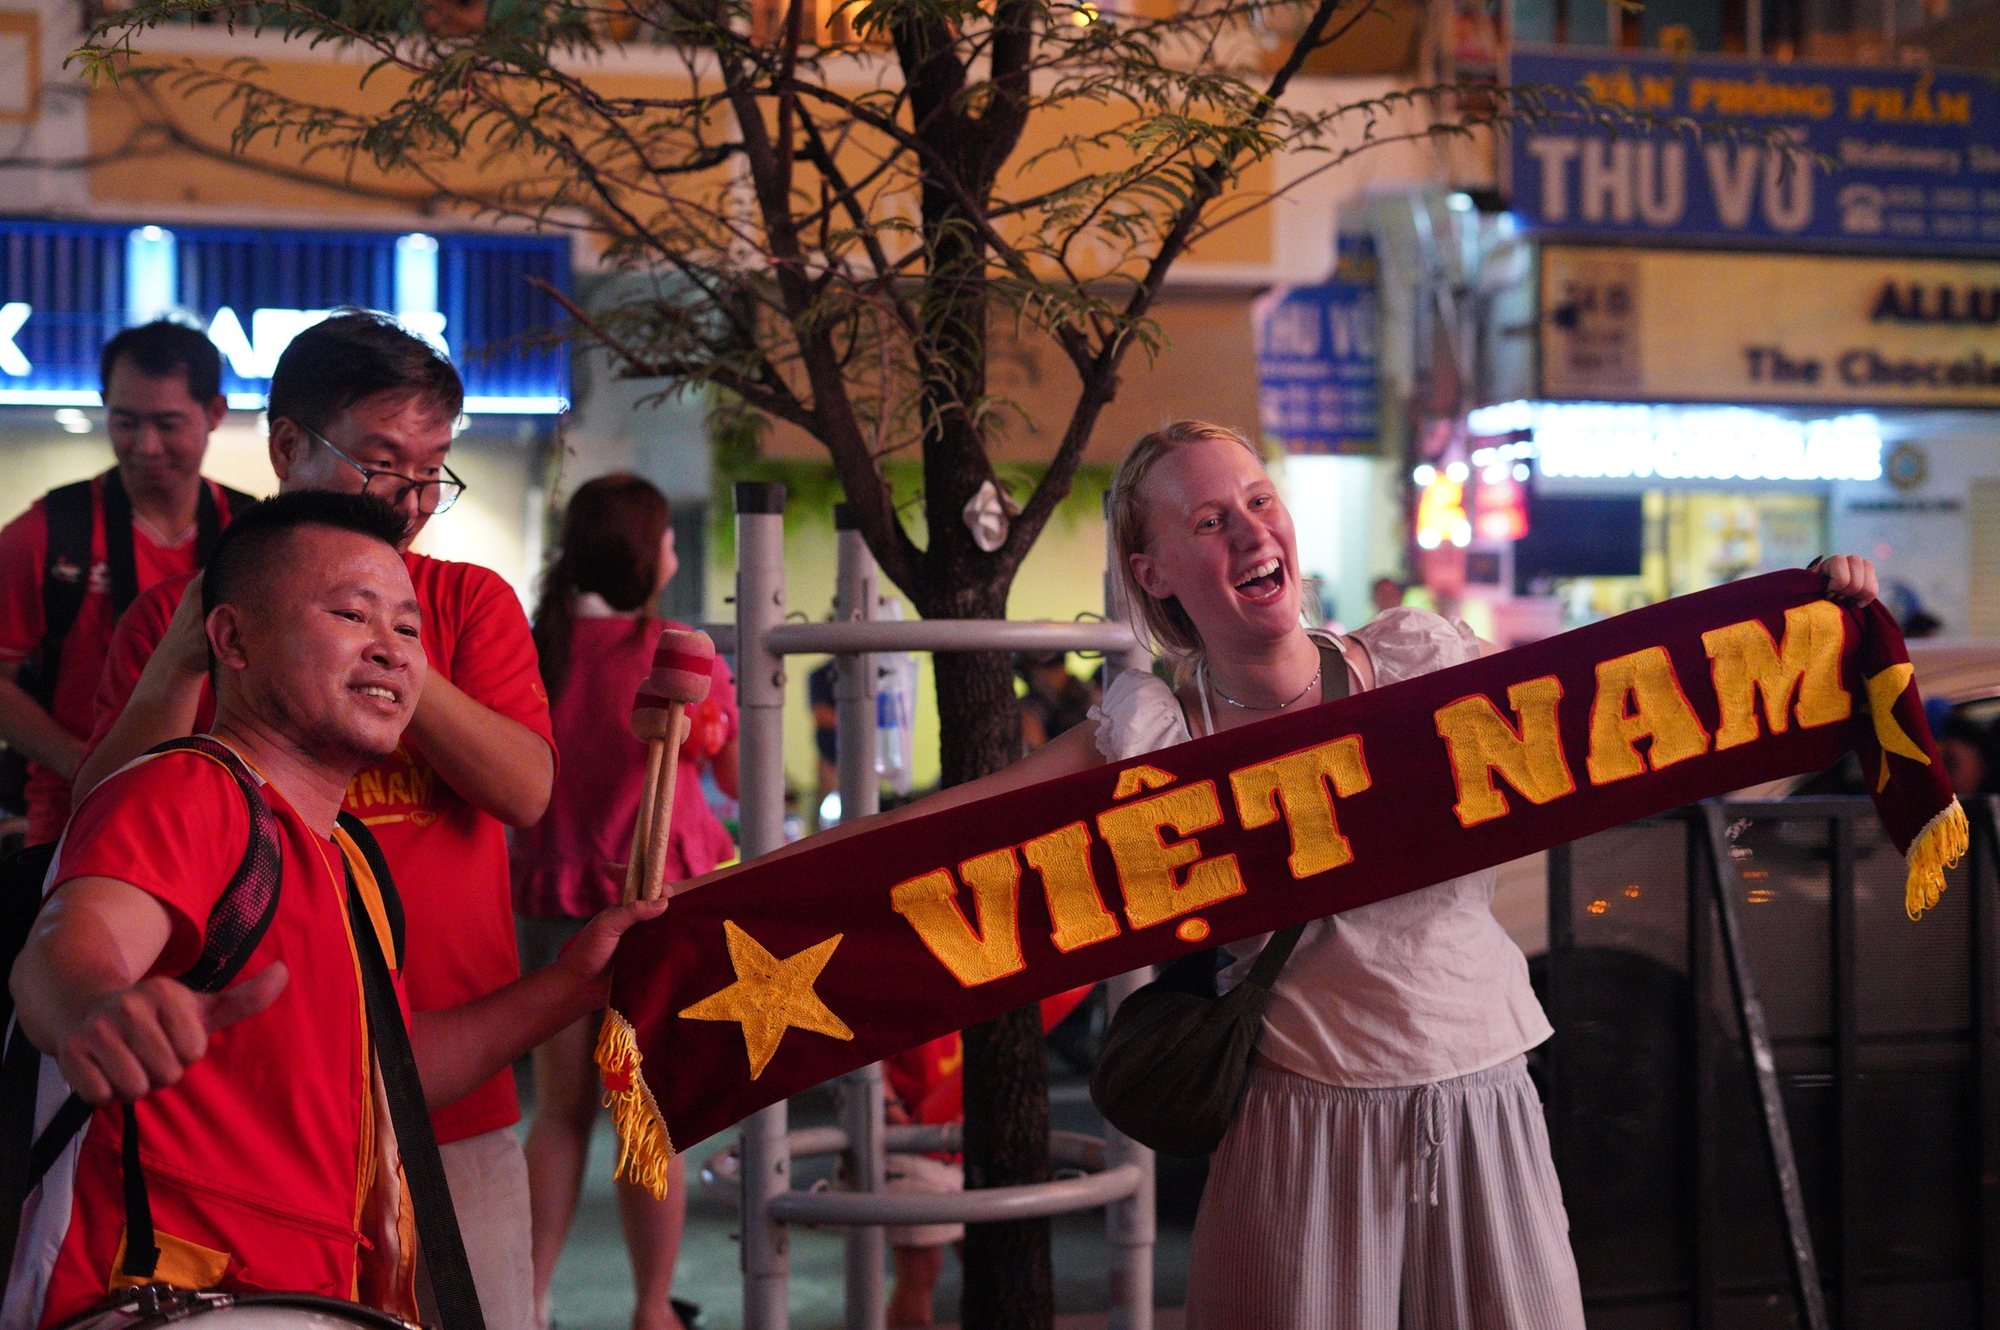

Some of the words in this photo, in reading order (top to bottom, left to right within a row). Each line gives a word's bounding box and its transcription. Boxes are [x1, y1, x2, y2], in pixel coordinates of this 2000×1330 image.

[1528, 135, 1688, 227] THU
[1743, 345, 1821, 385] The
[346, 764, 434, 810] TNAM
[889, 733, 1372, 988] VIỆT
[1433, 599, 1852, 829] NAM
